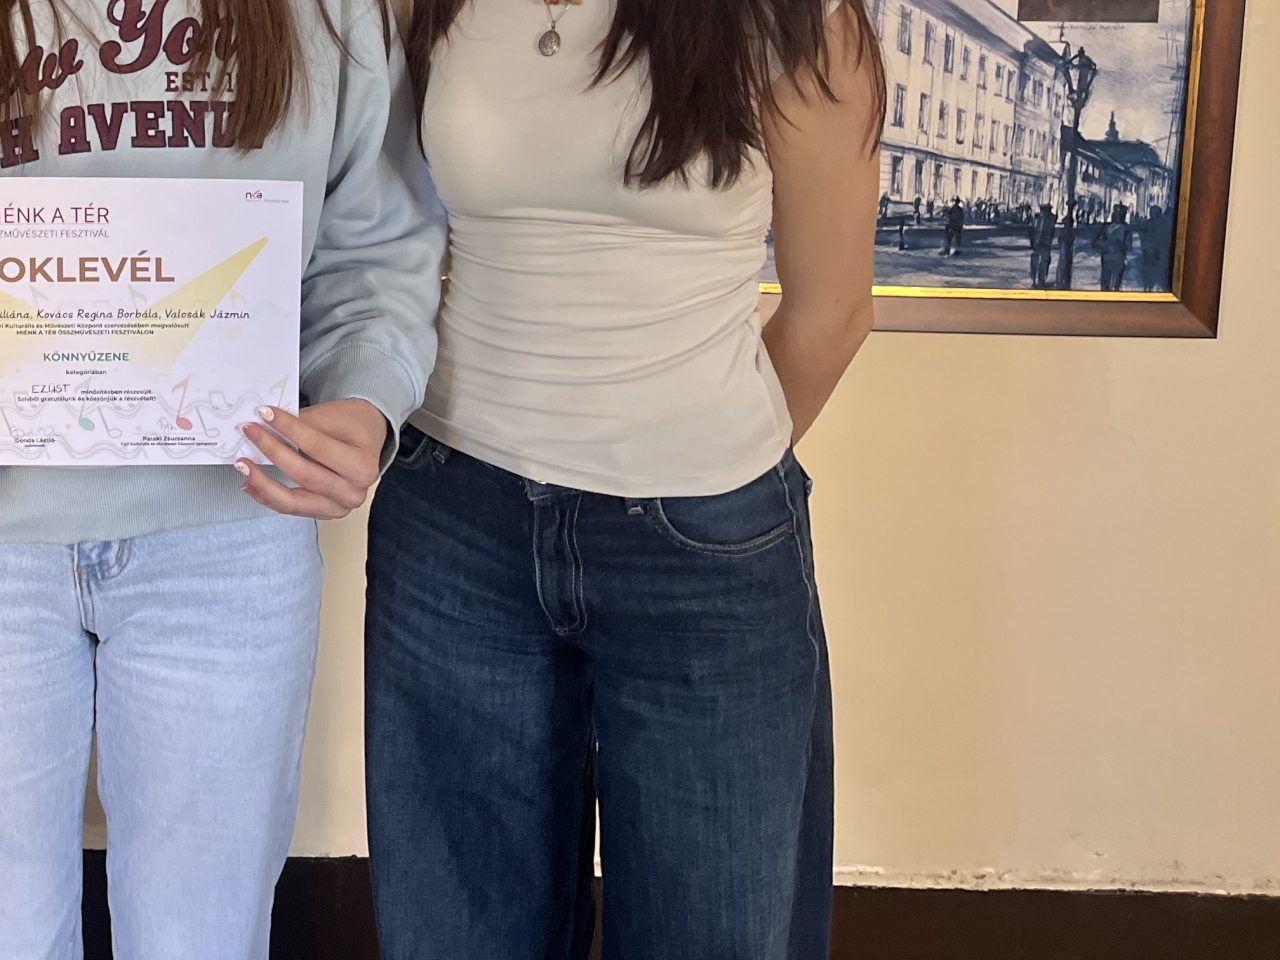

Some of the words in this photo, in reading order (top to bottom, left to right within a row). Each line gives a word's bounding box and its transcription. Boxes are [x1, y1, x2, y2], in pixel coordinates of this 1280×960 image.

[58, 100, 263, 155] AVENU
[51, 207, 65, 223] A
[70, 202, 109, 223] TÉR
[60, 227, 110, 238] FESZTIVÁL
[37, 309, 73, 319] Kovács
[77, 309, 113, 321] Regina
[117, 309, 162, 319] Borbála,
[209, 310, 250, 319] Jázmin
[43, 350, 129, 362] KÖNNYŰZENE
